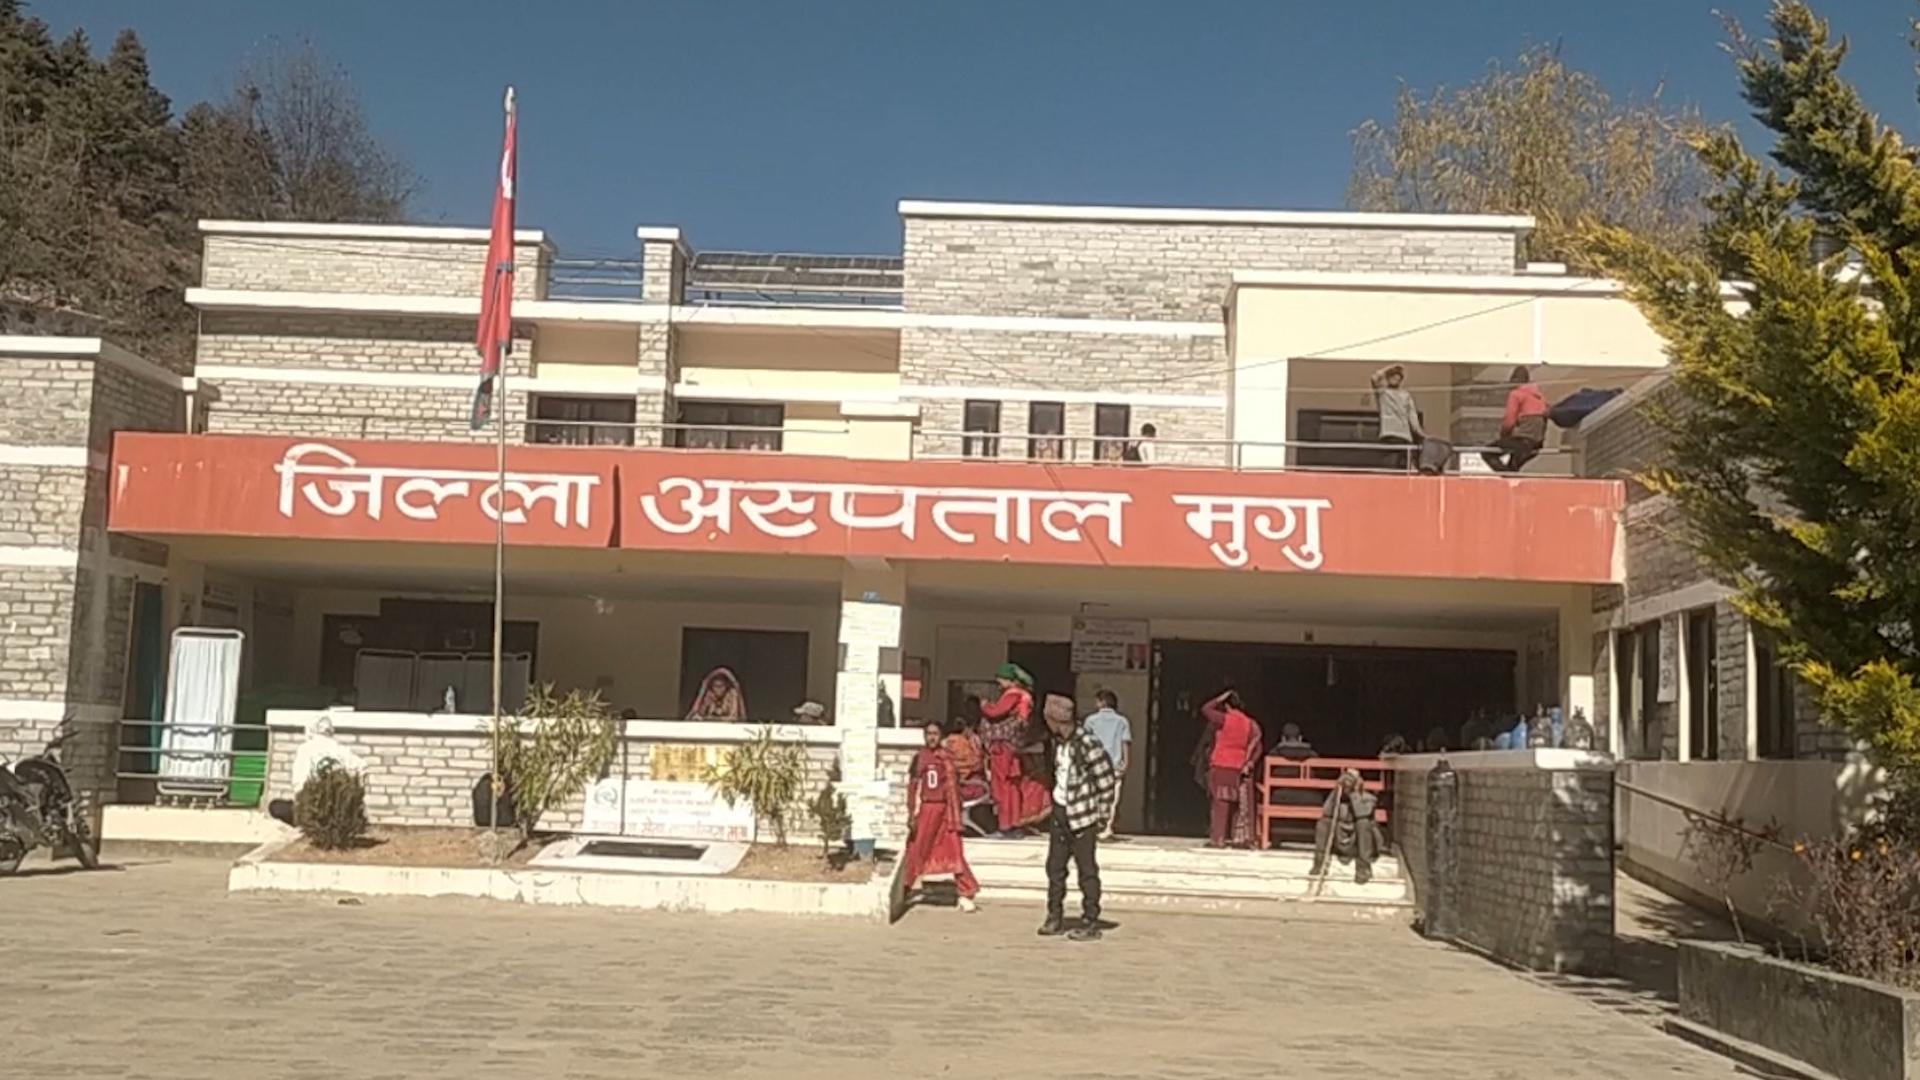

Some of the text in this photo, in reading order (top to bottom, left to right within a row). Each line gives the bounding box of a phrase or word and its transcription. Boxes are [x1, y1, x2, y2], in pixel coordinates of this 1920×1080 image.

[274, 443, 1333, 571] जिल्ला अस्पताल मुगु
